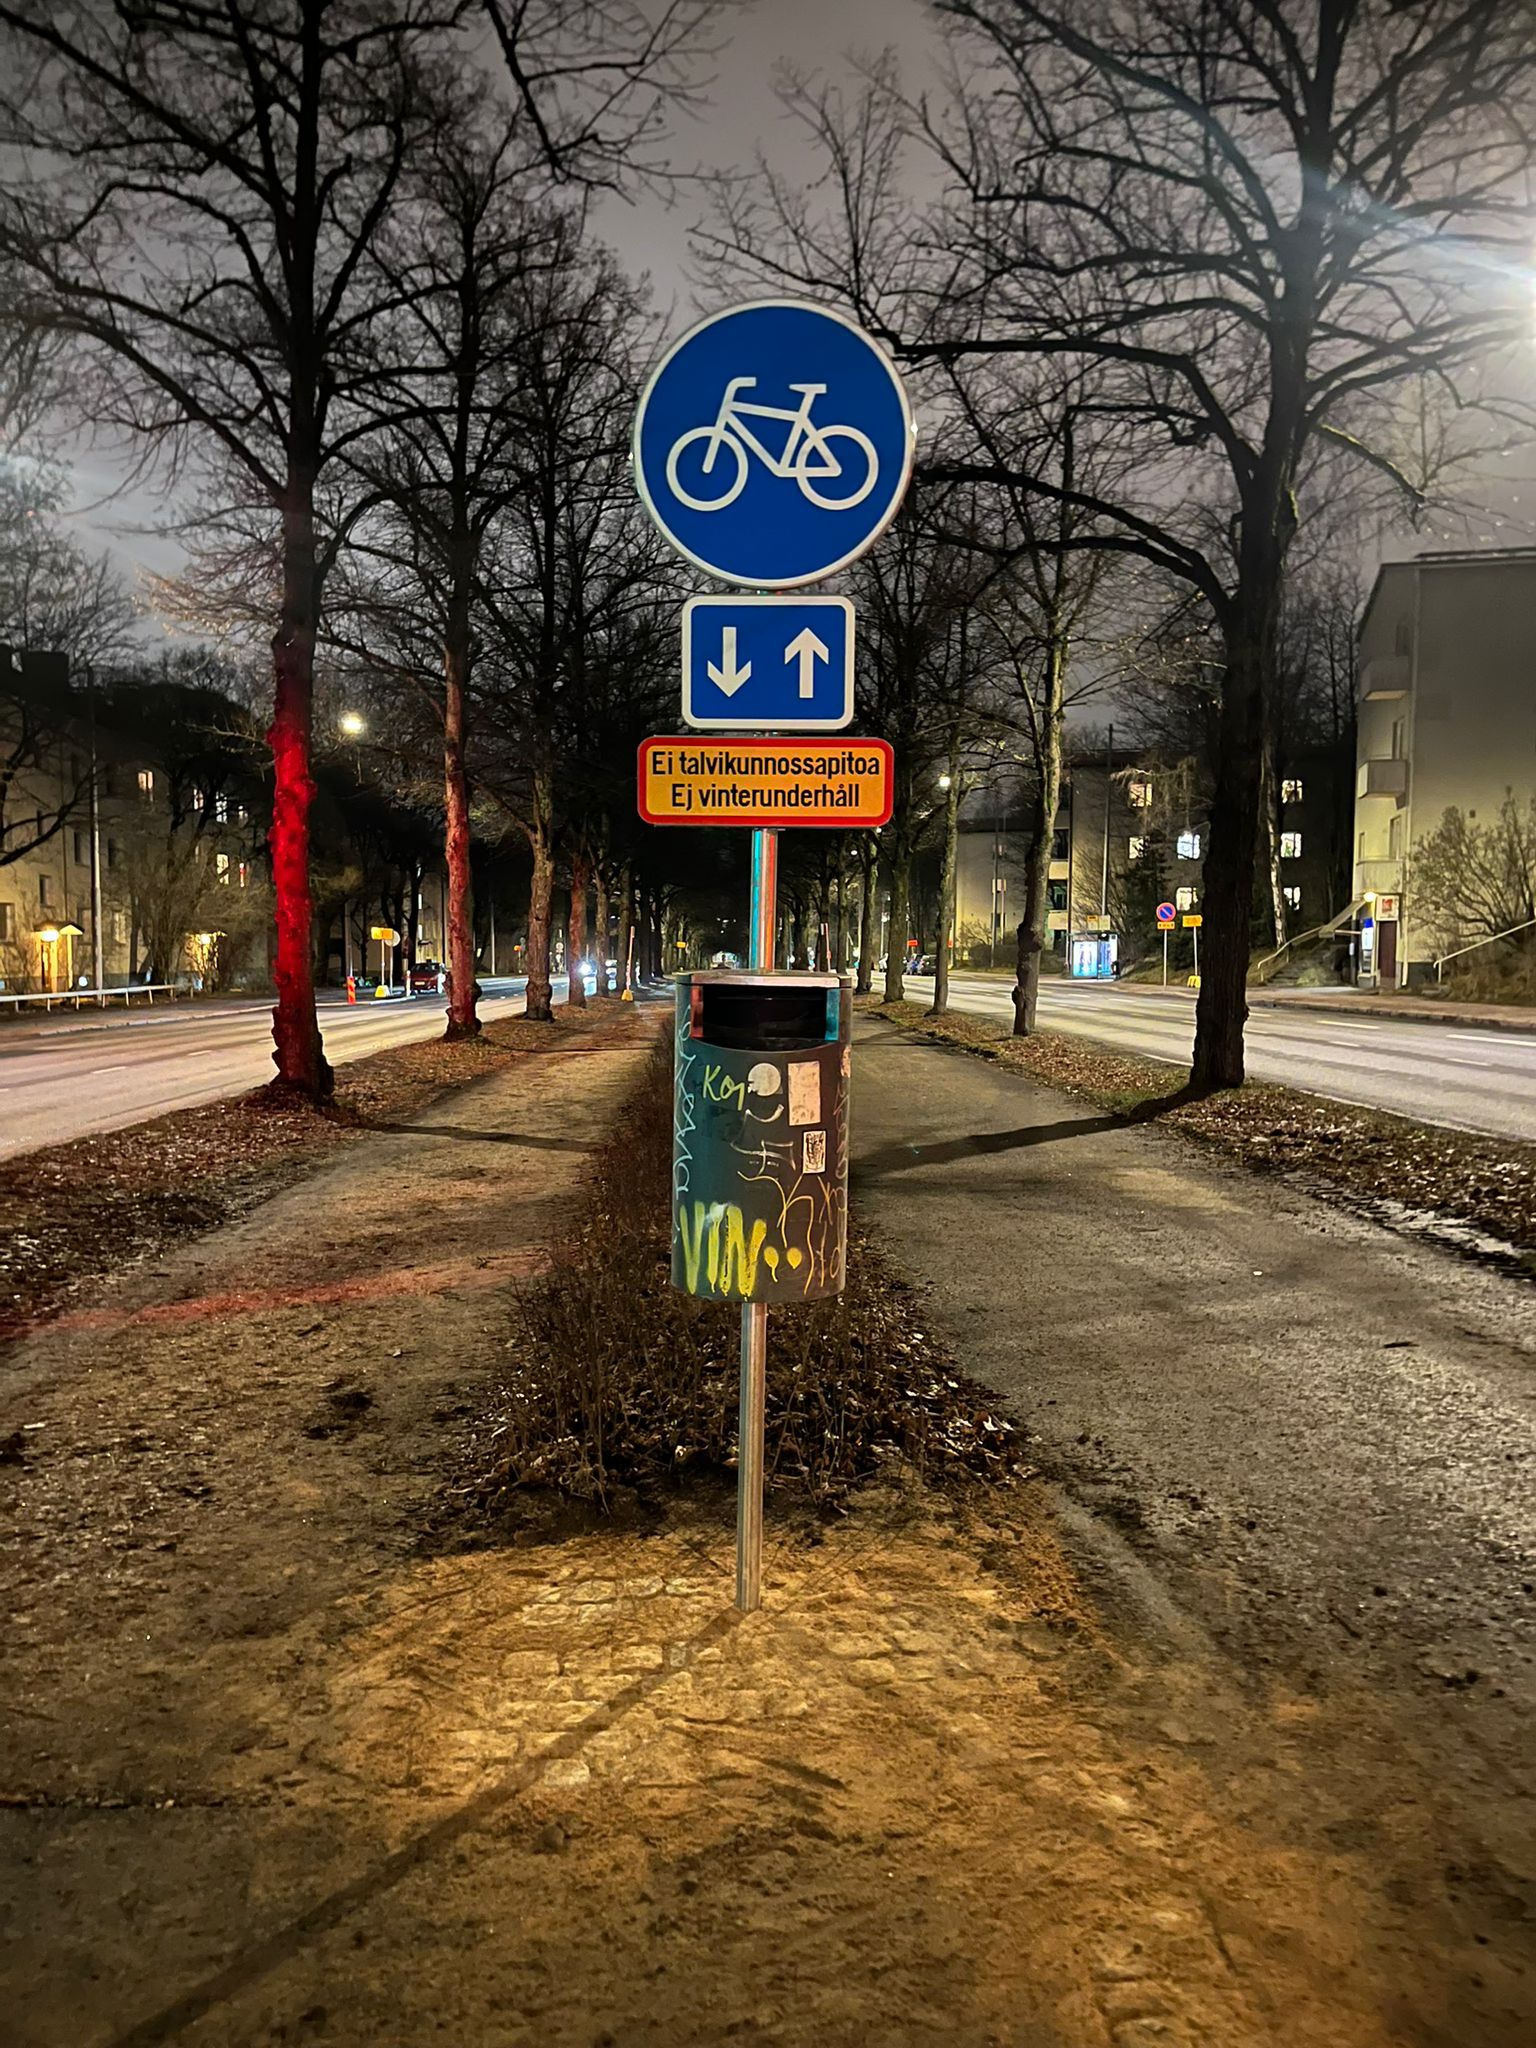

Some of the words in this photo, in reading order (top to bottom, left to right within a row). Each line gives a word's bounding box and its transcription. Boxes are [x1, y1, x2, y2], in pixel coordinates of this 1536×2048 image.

[652, 751, 673, 775] Ei
[679, 751, 880, 779] talvikunnossapitoa
[671, 783, 693, 812] Ej
[698, 783, 860, 807] vinterunderhåll
